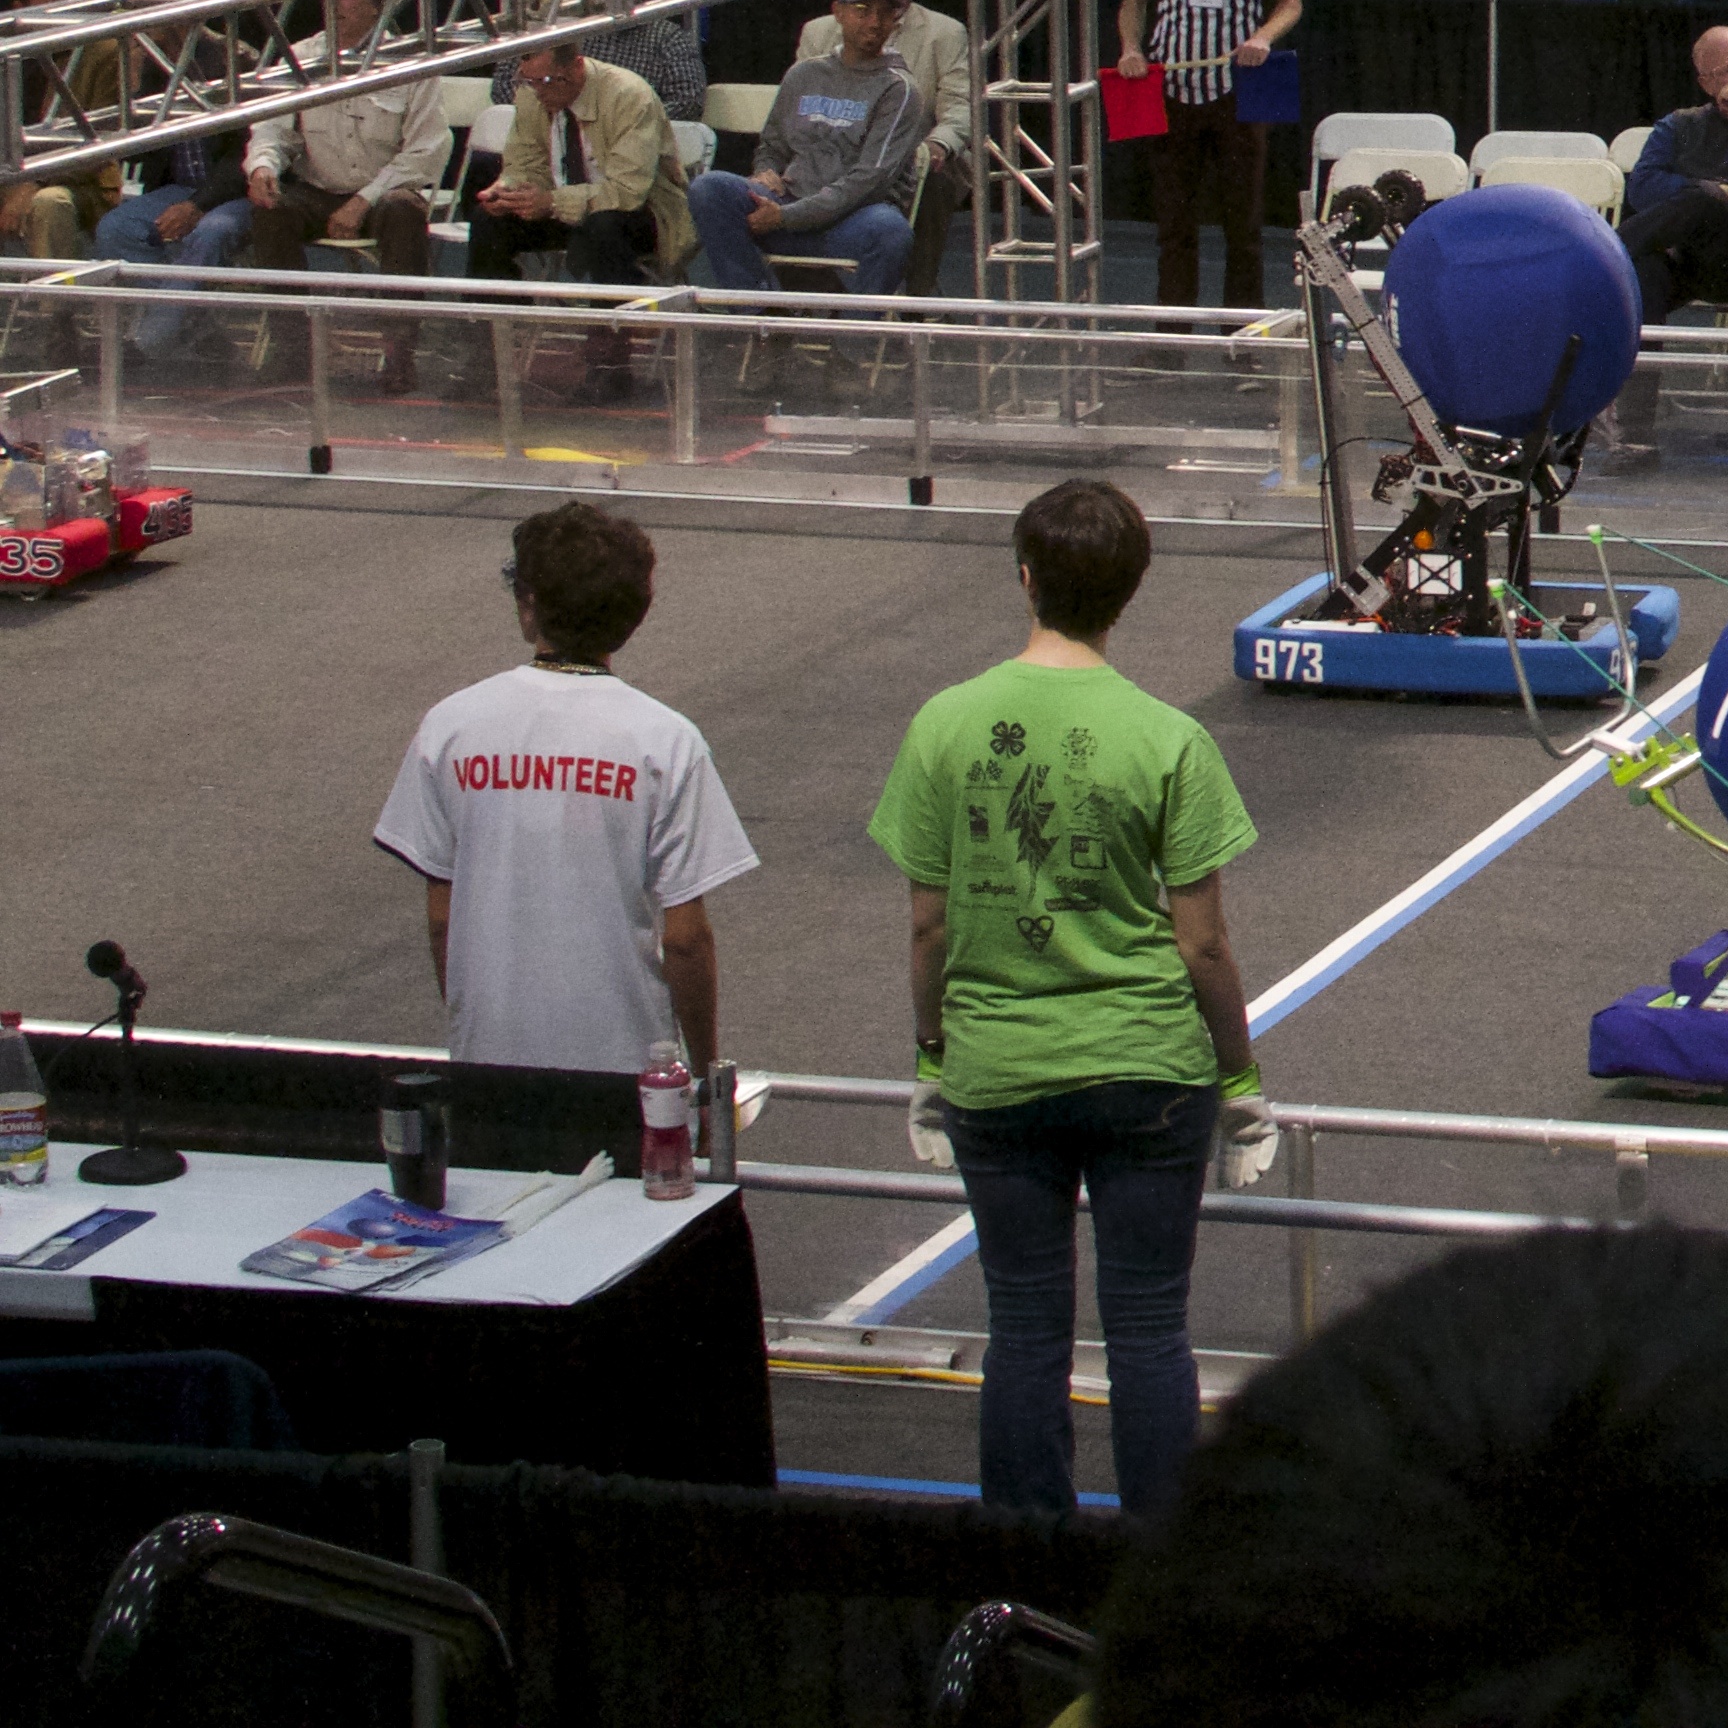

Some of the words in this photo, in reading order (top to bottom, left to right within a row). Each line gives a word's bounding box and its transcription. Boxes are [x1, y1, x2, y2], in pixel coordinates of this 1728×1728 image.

[141, 494, 194, 539] 435
[1254, 638, 1325, 684] 973
[453, 754, 638, 802] VOLUNTEER
